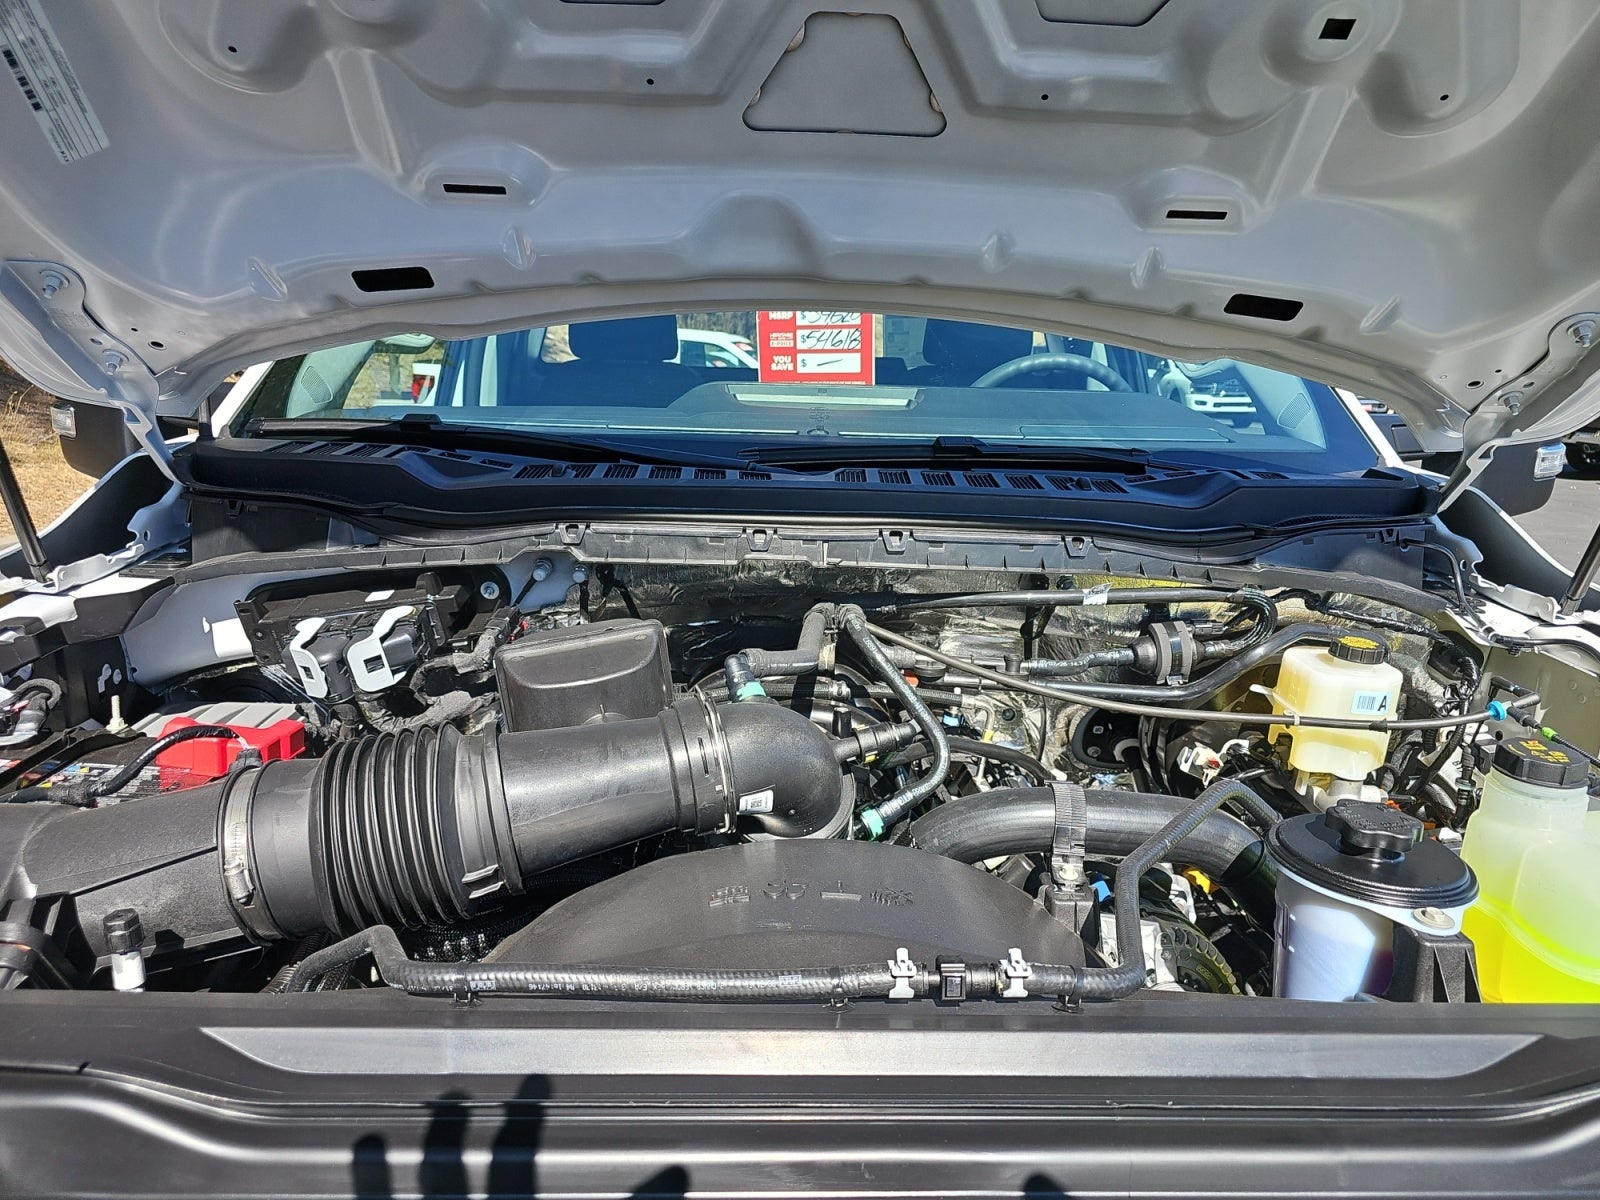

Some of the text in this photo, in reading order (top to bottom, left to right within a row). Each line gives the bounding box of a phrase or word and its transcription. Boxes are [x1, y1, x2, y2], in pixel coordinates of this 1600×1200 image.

[773, 355, 791, 364] YOU
[771, 363, 794, 371] SAVE
[1377, 695, 1388, 711] A
